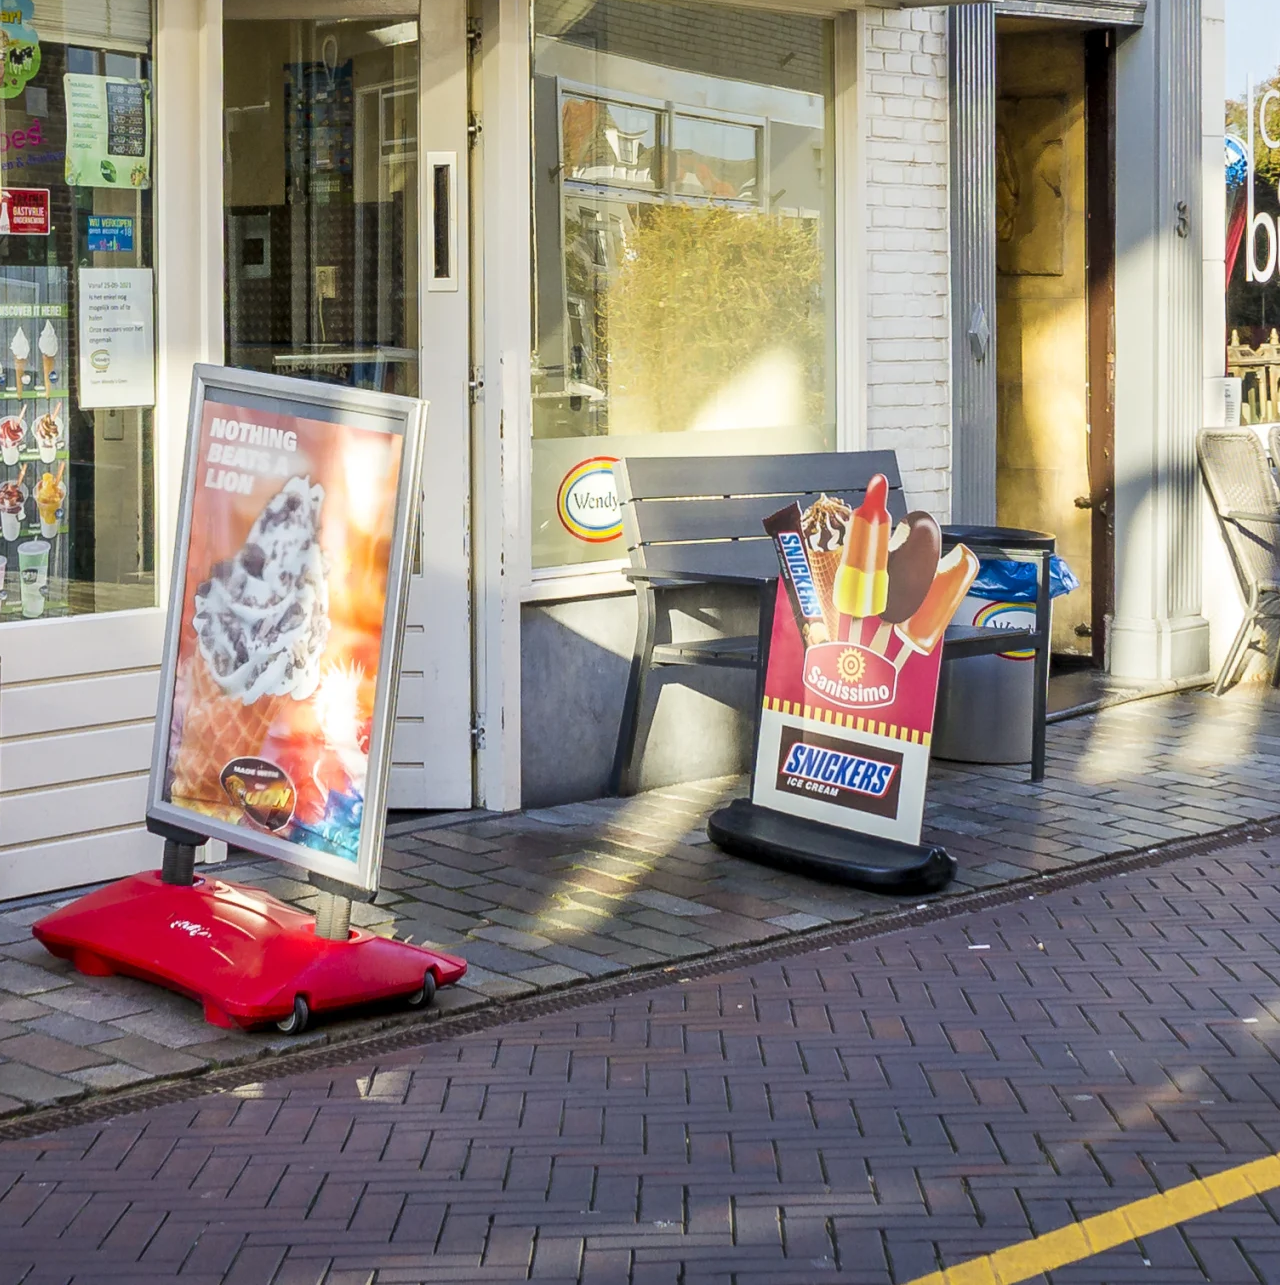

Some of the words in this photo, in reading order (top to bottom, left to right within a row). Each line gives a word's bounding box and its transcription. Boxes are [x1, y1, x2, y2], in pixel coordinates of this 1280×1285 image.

[13, 206, 44, 216] GASTVRIJE
[101, 218, 132, 227] VERKOPEN
[33, 305, 40, 316] IT
[41, 305, 62, 316] HERE!
[210, 417, 297, 452] NOTHING
[207, 442, 271, 473] BEATS
[273, 455, 289, 477] A
[205, 468, 255, 495] LION
[780, 535, 821, 616] SNICKERS
[807, 665, 890, 703] Sanissimo
[233, 765, 256, 776] MADE
[786, 744, 891, 794] SNICKERS
[786, 776, 803, 788] ICE
[805, 779, 839, 797] CREAM
